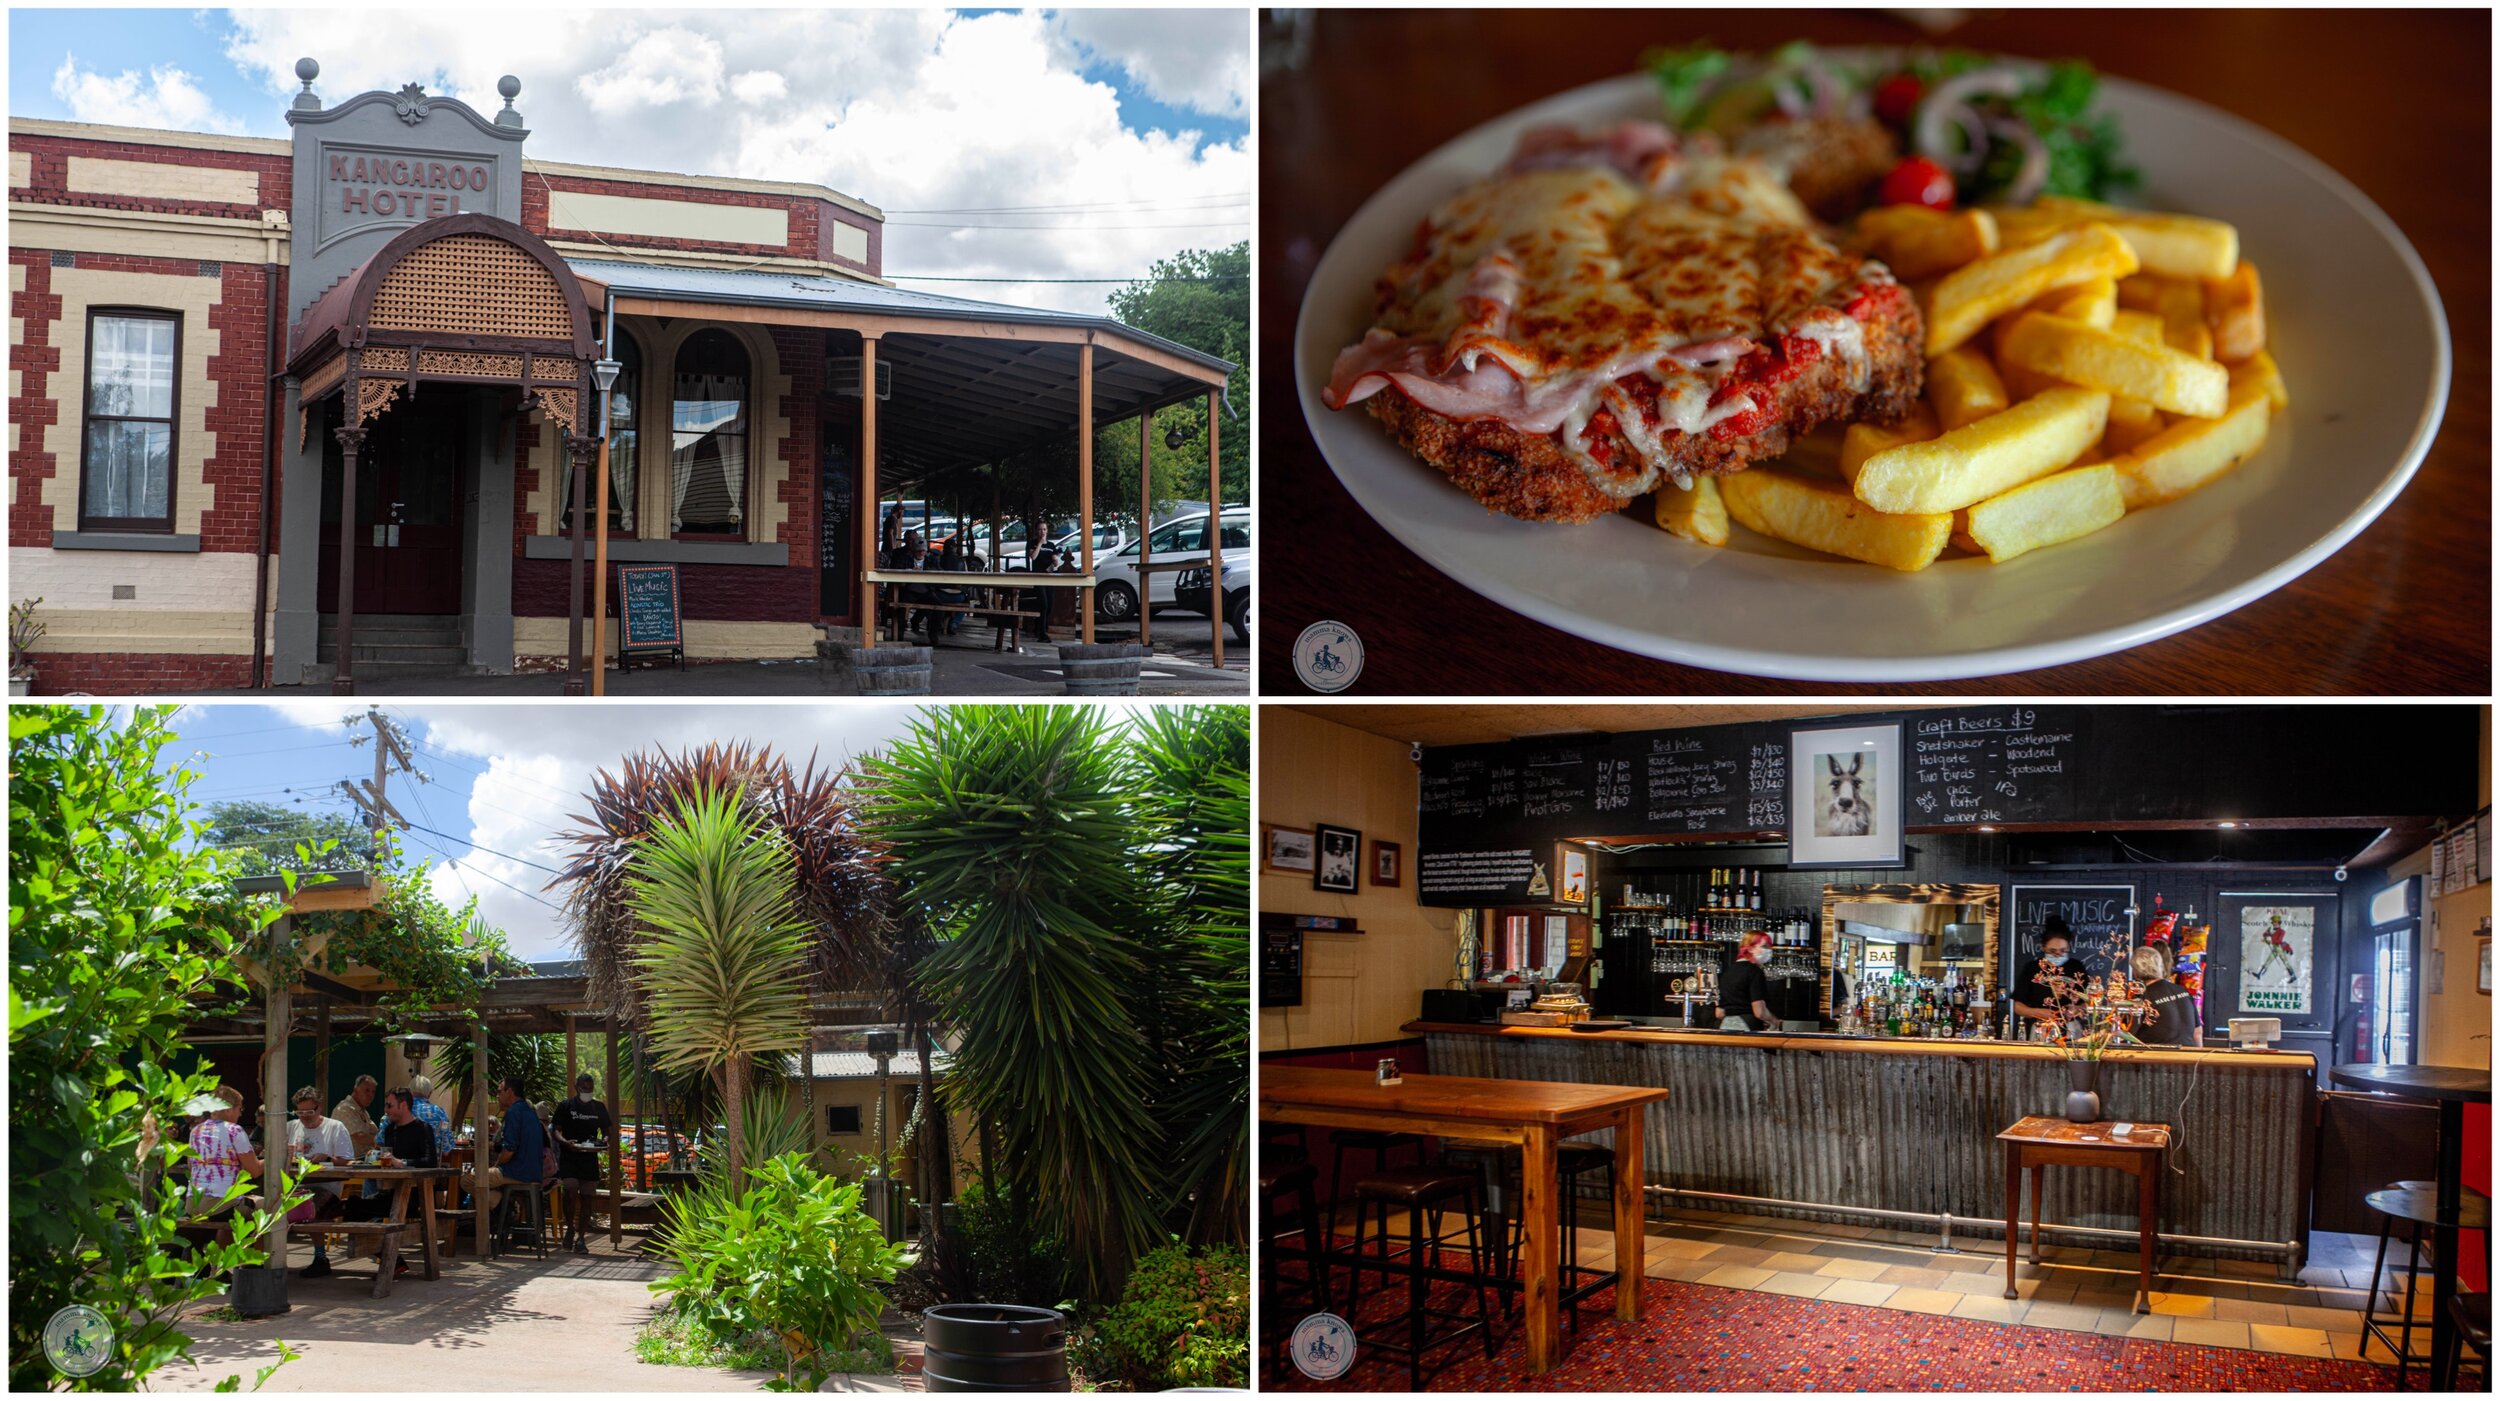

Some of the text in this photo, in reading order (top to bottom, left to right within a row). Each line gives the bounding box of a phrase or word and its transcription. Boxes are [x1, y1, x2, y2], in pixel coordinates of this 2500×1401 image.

[329, 154, 488, 192] KANGAROO
[343, 187, 460, 218] HOTEL
[1917, 708, 2036, 738] Craft Beers $9
[1653, 737, 1703, 752] Red Wine
[1919, 754, 1969, 771] Holgate
[2005, 745, 2055, 760] Woodend
[1943, 765, 1976, 781] Birds
[2005, 760, 2063, 777] Spotswood
[1980, 809, 2002, 821] ale
[2060, 900, 2117, 924] MUSIC
[2246, 1000, 2302, 1010] WALKER
